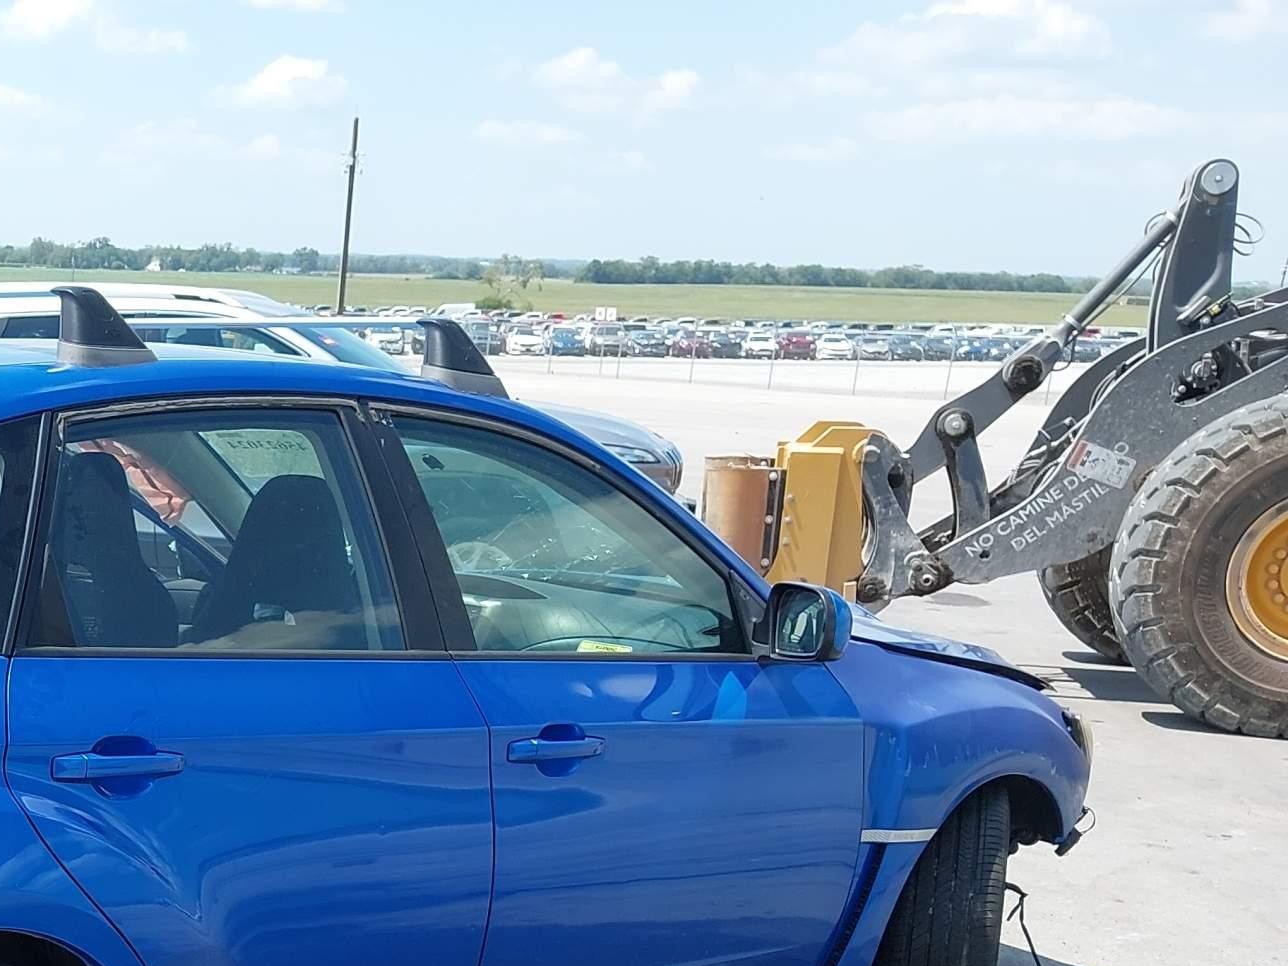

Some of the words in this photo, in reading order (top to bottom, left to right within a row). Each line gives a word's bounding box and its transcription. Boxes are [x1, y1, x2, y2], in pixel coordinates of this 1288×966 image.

[964, 533, 994, 557] NO
[996, 487, 1064, 536] CAMINE
[1010, 525, 1047, 552] DEL
